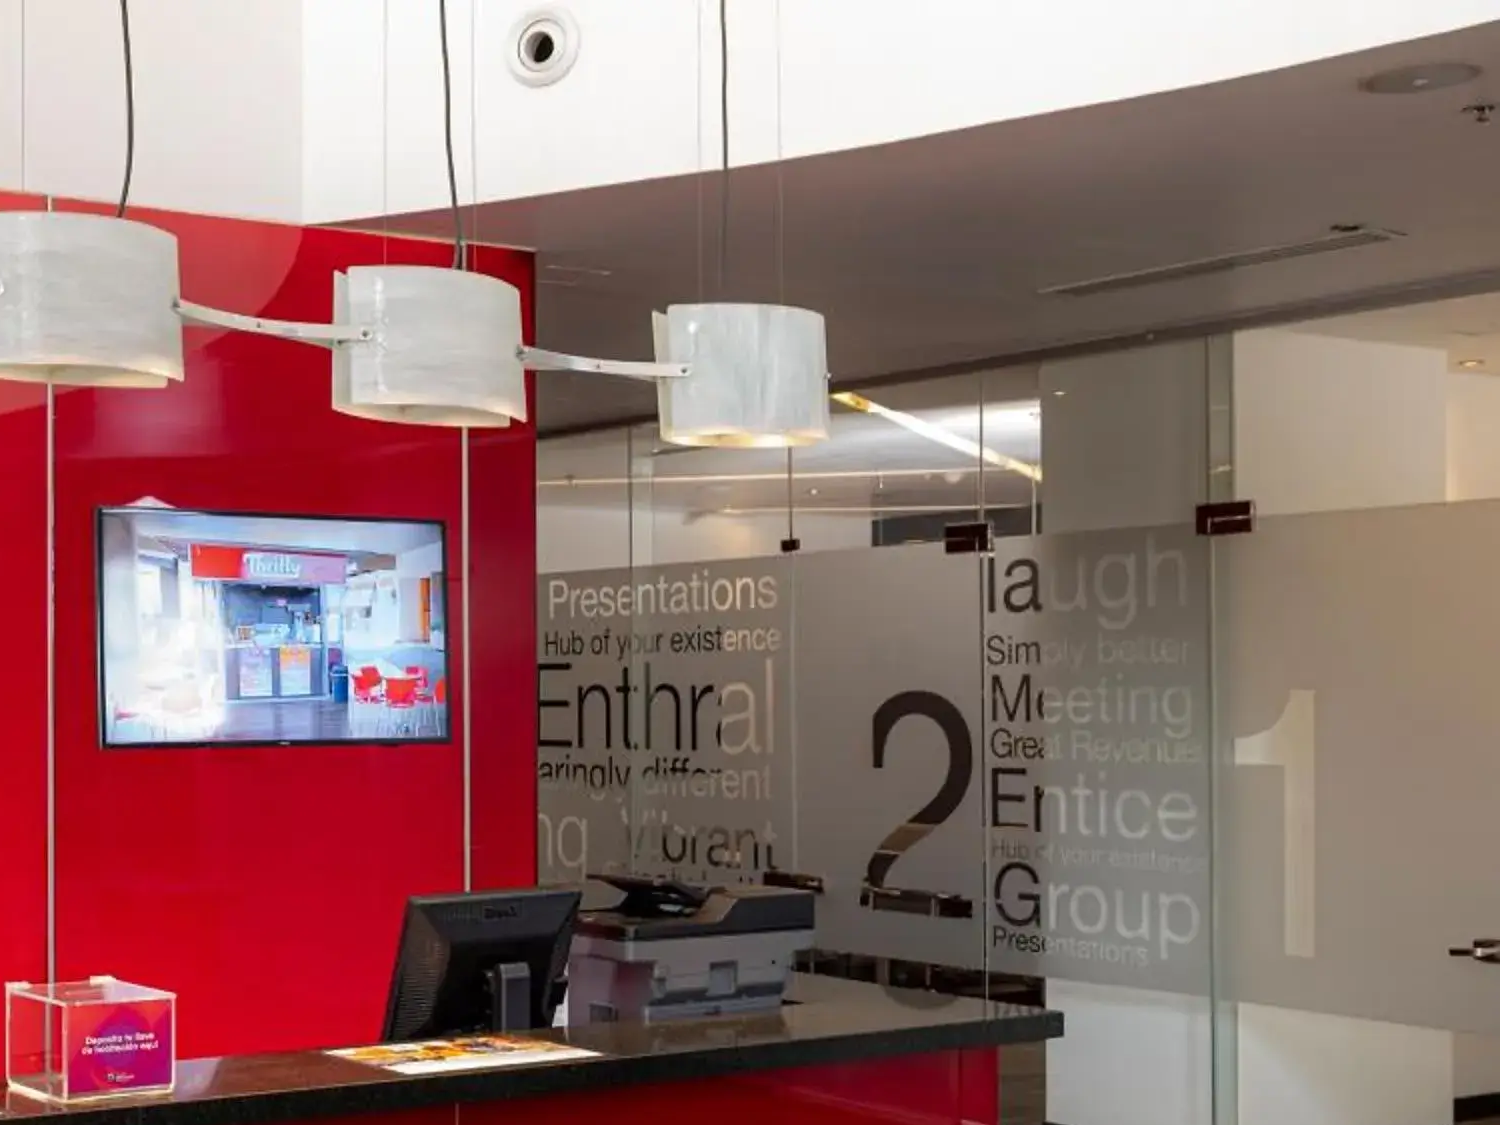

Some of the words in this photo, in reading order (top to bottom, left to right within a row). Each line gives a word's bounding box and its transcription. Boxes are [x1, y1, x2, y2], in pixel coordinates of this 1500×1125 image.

[549, 570, 779, 619] Presentations
[986, 533, 1189, 631] laugh
[544, 630, 585, 656] Hub
[590, 626, 611, 655] of
[616, 632, 665, 661] your
[670, 625, 783, 653] existence
[986, 634, 1087, 670] Simply
[537, 658, 776, 755] Enthral
[990, 671, 1193, 739] Meeting
[989, 728, 1063, 762] Great
[641, 757, 773, 800] different
[860, 690, 973, 918] 2
[990, 766, 1199, 842] Entice
[1234, 688, 1315, 957] 1
[991, 838, 1030, 860] Hub
[1060, 847, 1106, 870] your
[993, 861, 1202, 960] Group
[991, 926, 1150, 968] Presentations
